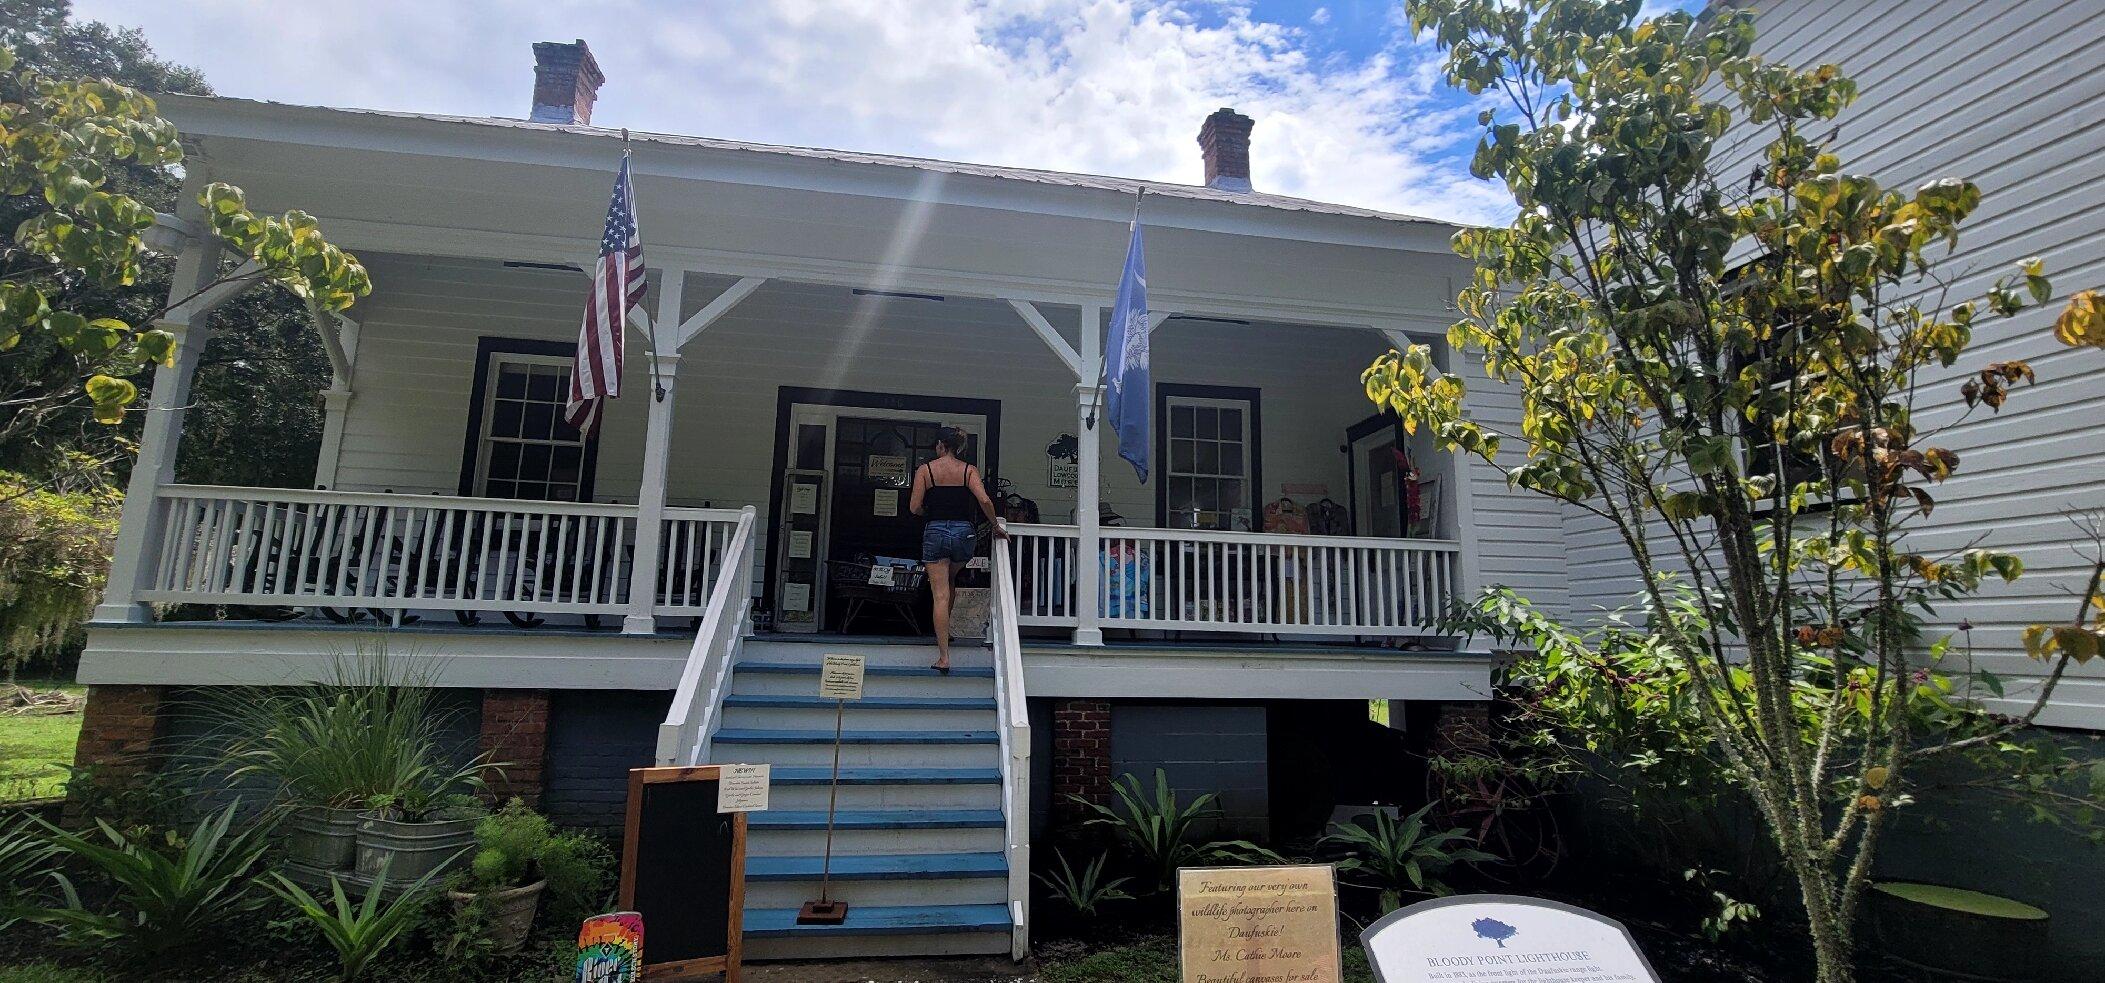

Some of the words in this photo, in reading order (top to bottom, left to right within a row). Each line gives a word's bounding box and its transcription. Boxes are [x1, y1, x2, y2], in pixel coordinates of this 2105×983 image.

[1054, 464, 1078, 472] DAUFU
[1199, 881, 1246, 898] Featuring
[1249, 884, 1265, 892] our
[1267, 884, 1288, 896] very
[1289, 883, 1308, 891] own
[1191, 903, 1229, 921] wildlife
[1225, 902, 1285, 921] photographer
[1285, 900, 1306, 913] here
[1306, 905, 1318, 913] on
[1228, 925, 1285, 942] Daufuskie!
[1236, 947, 1266, 961] Cathie
[1268, 947, 1302, 960] Moore
[1426, 956, 1475, 967] BLOODY
[1477, 955, 1514, 965] POINT
[1515, 951, 1592, 963] LIGHTHOUSE
[1197, 971, 1247, 983] Beautiful
[1285, 969, 1299, 983] for
[1301, 968, 1319, 981] sale
